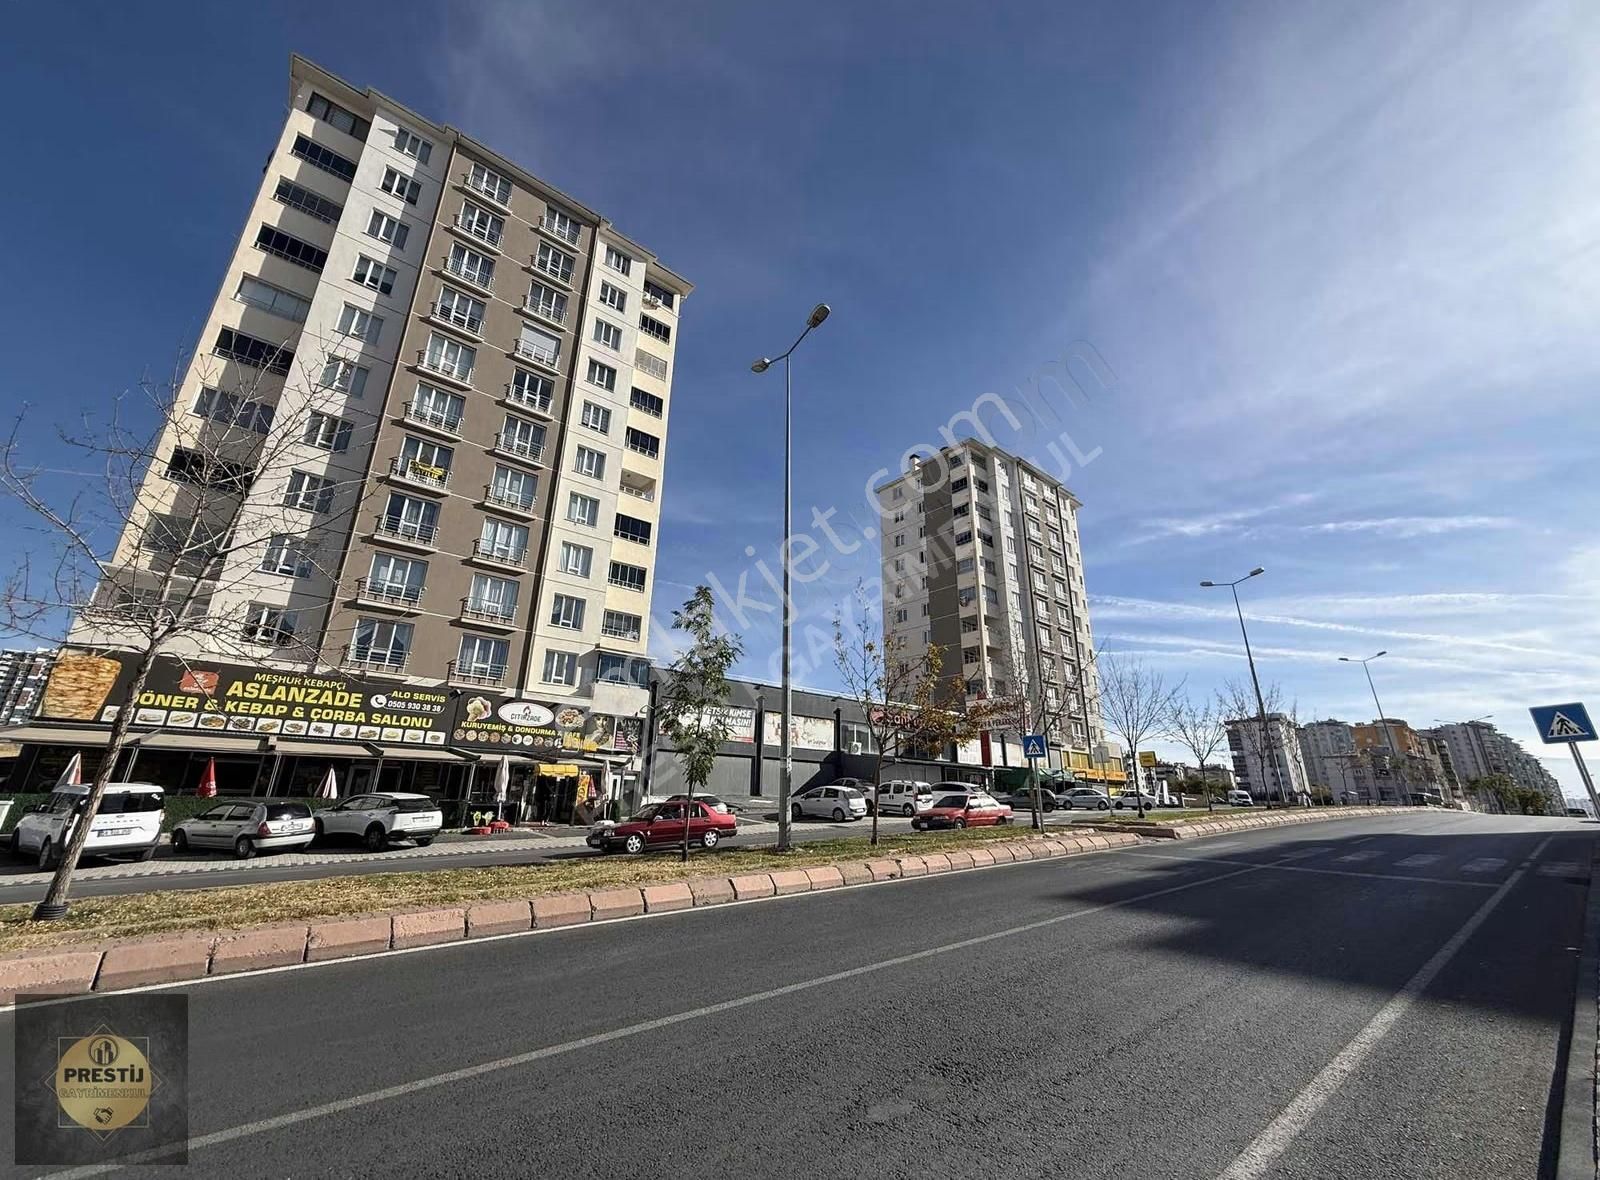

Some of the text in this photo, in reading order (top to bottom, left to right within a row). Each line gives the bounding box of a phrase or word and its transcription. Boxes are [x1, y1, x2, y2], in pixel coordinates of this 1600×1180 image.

[254, 672, 301, 685] MEŞHUR
[226, 680, 363, 709] ASLANZADE
[391, 690, 446, 703] ALO SERVİS
[387, 700, 406, 709] 0505
[407, 702, 421, 710] 930
[204, 699, 218, 711] &
[224, 700, 288, 717] KEBAP
[292, 707, 304, 718] &
[310, 707, 366, 723] ÇORBA
[370, 712, 433, 728] SALONU
[710, 714, 752, 727] KLMASIN!
[461, 720, 506, 733] KURUYEMİŞ
[515, 726, 556, 736] DONDURMA
